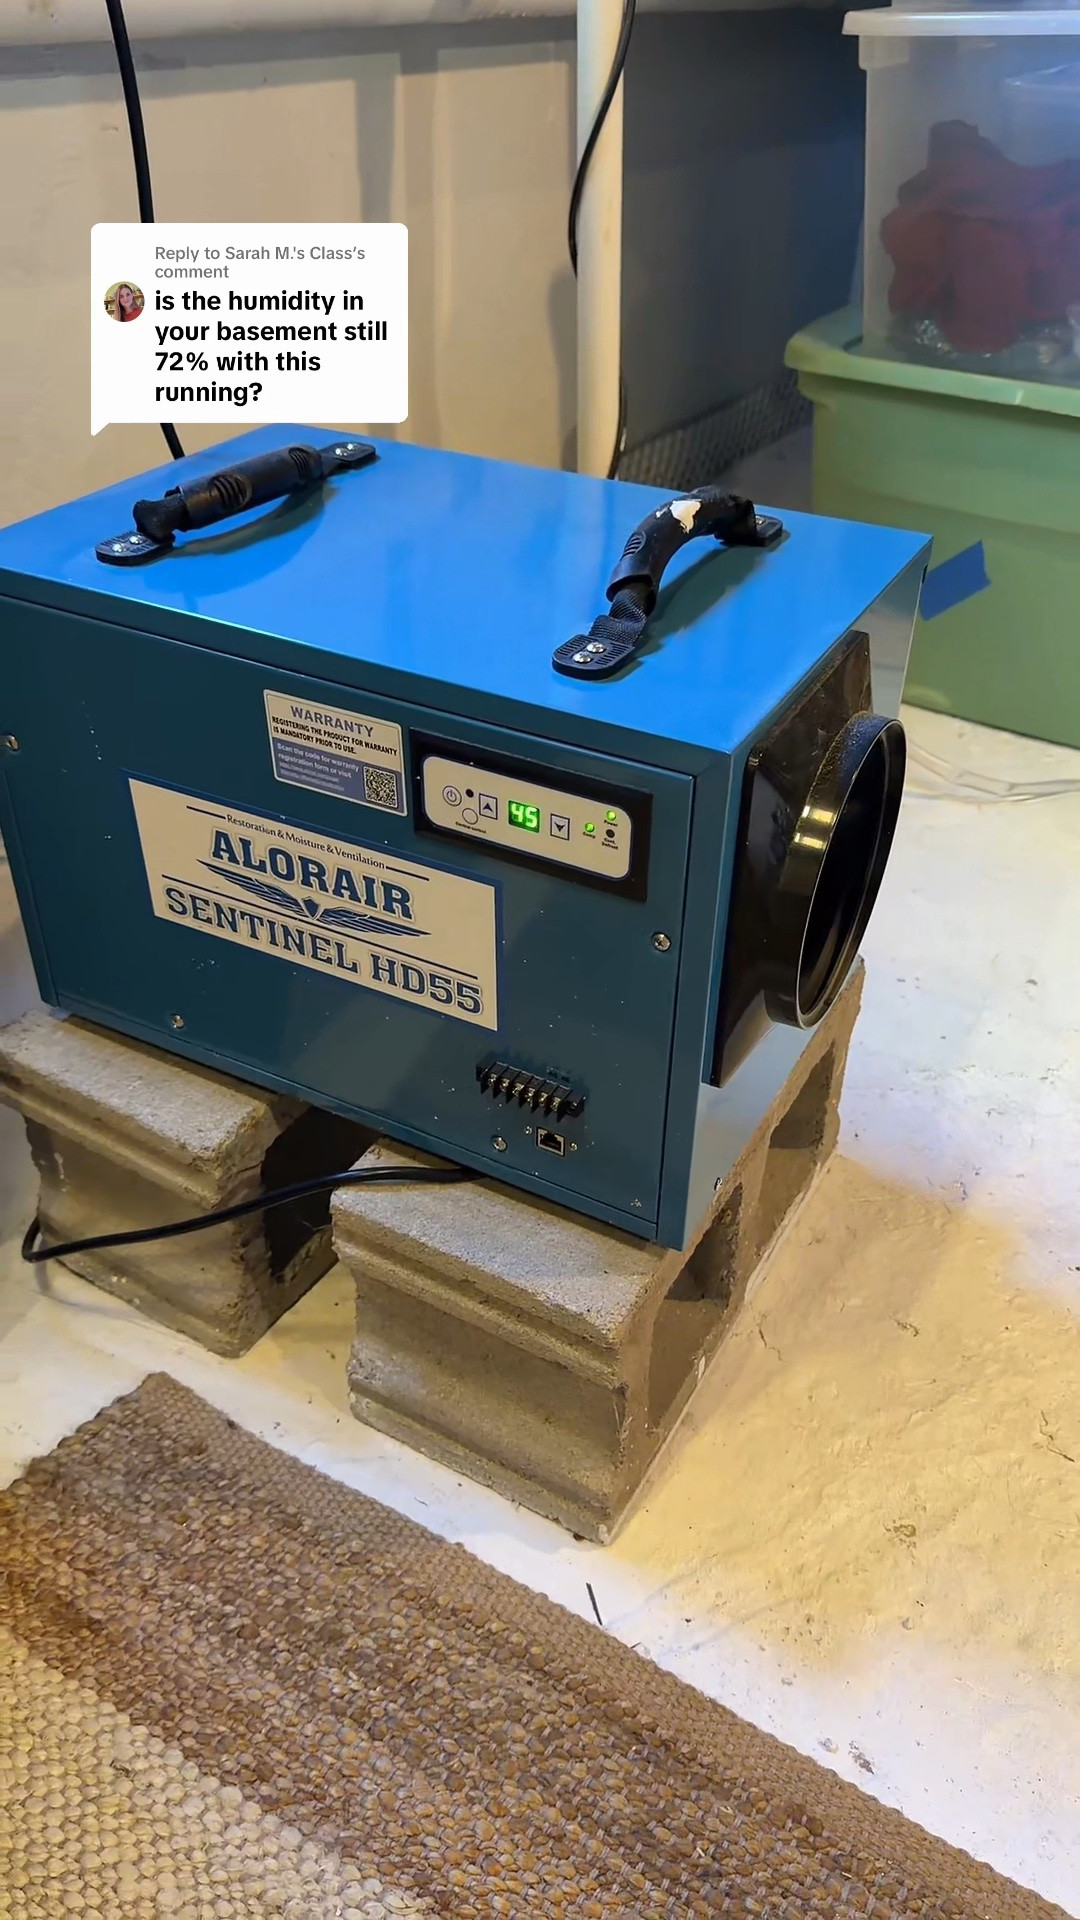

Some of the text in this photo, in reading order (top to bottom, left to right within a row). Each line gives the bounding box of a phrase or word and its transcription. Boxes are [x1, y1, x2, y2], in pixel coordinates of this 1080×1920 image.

[272, 716, 398, 756] REGISTERING THE PRODUCT FOR WARRANTY
[290, 706, 374, 737] WARRANTY
[280, 728, 314, 744] MANDATORY
[315, 737, 333, 748] PRIOR
[334, 742, 342, 750] TO
[343, 745, 357, 754] USE.
[227, 814, 276, 837] Restoration
[277, 829, 285, 839] &
[286, 832, 326, 852] Moisture
[510, 803, 538, 828] 45
[211, 829, 413, 920] ALORAIR
[163, 886, 483, 1015] SENTINEL HD55
